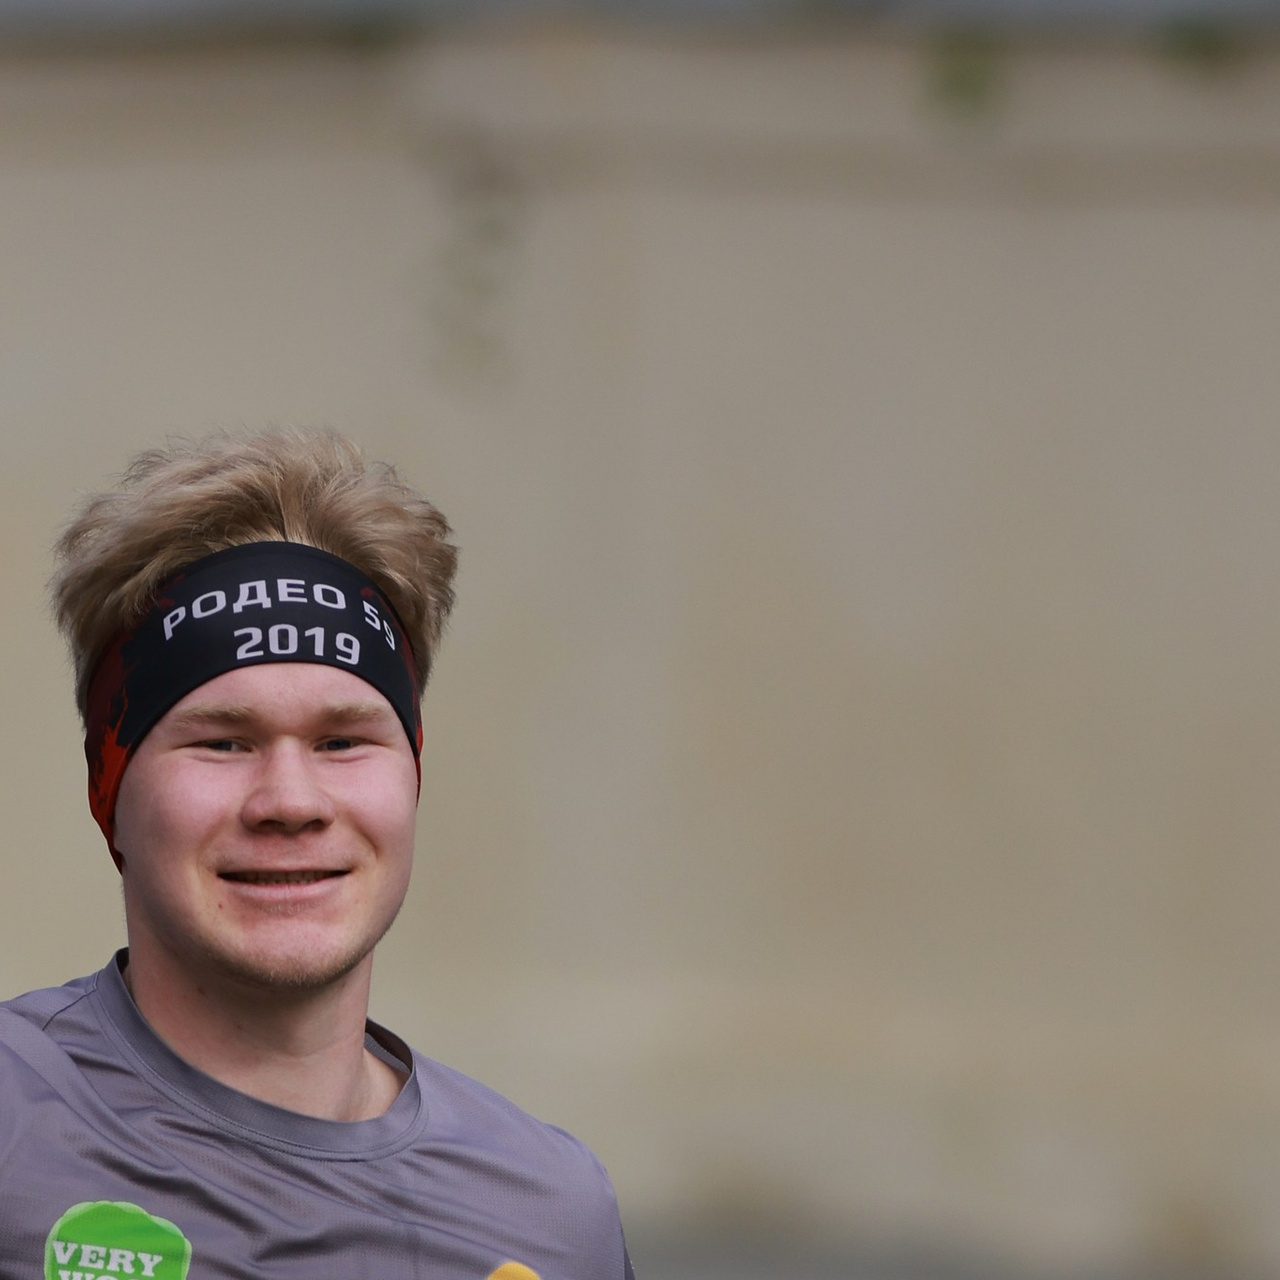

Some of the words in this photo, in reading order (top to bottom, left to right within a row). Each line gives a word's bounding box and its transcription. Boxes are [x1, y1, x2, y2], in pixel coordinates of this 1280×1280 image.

[163, 578, 346, 641] РОДЕО
[362, 600, 396, 651] 59
[233, 623, 361, 665] 2019
[52, 1240, 163, 1277] VERY
